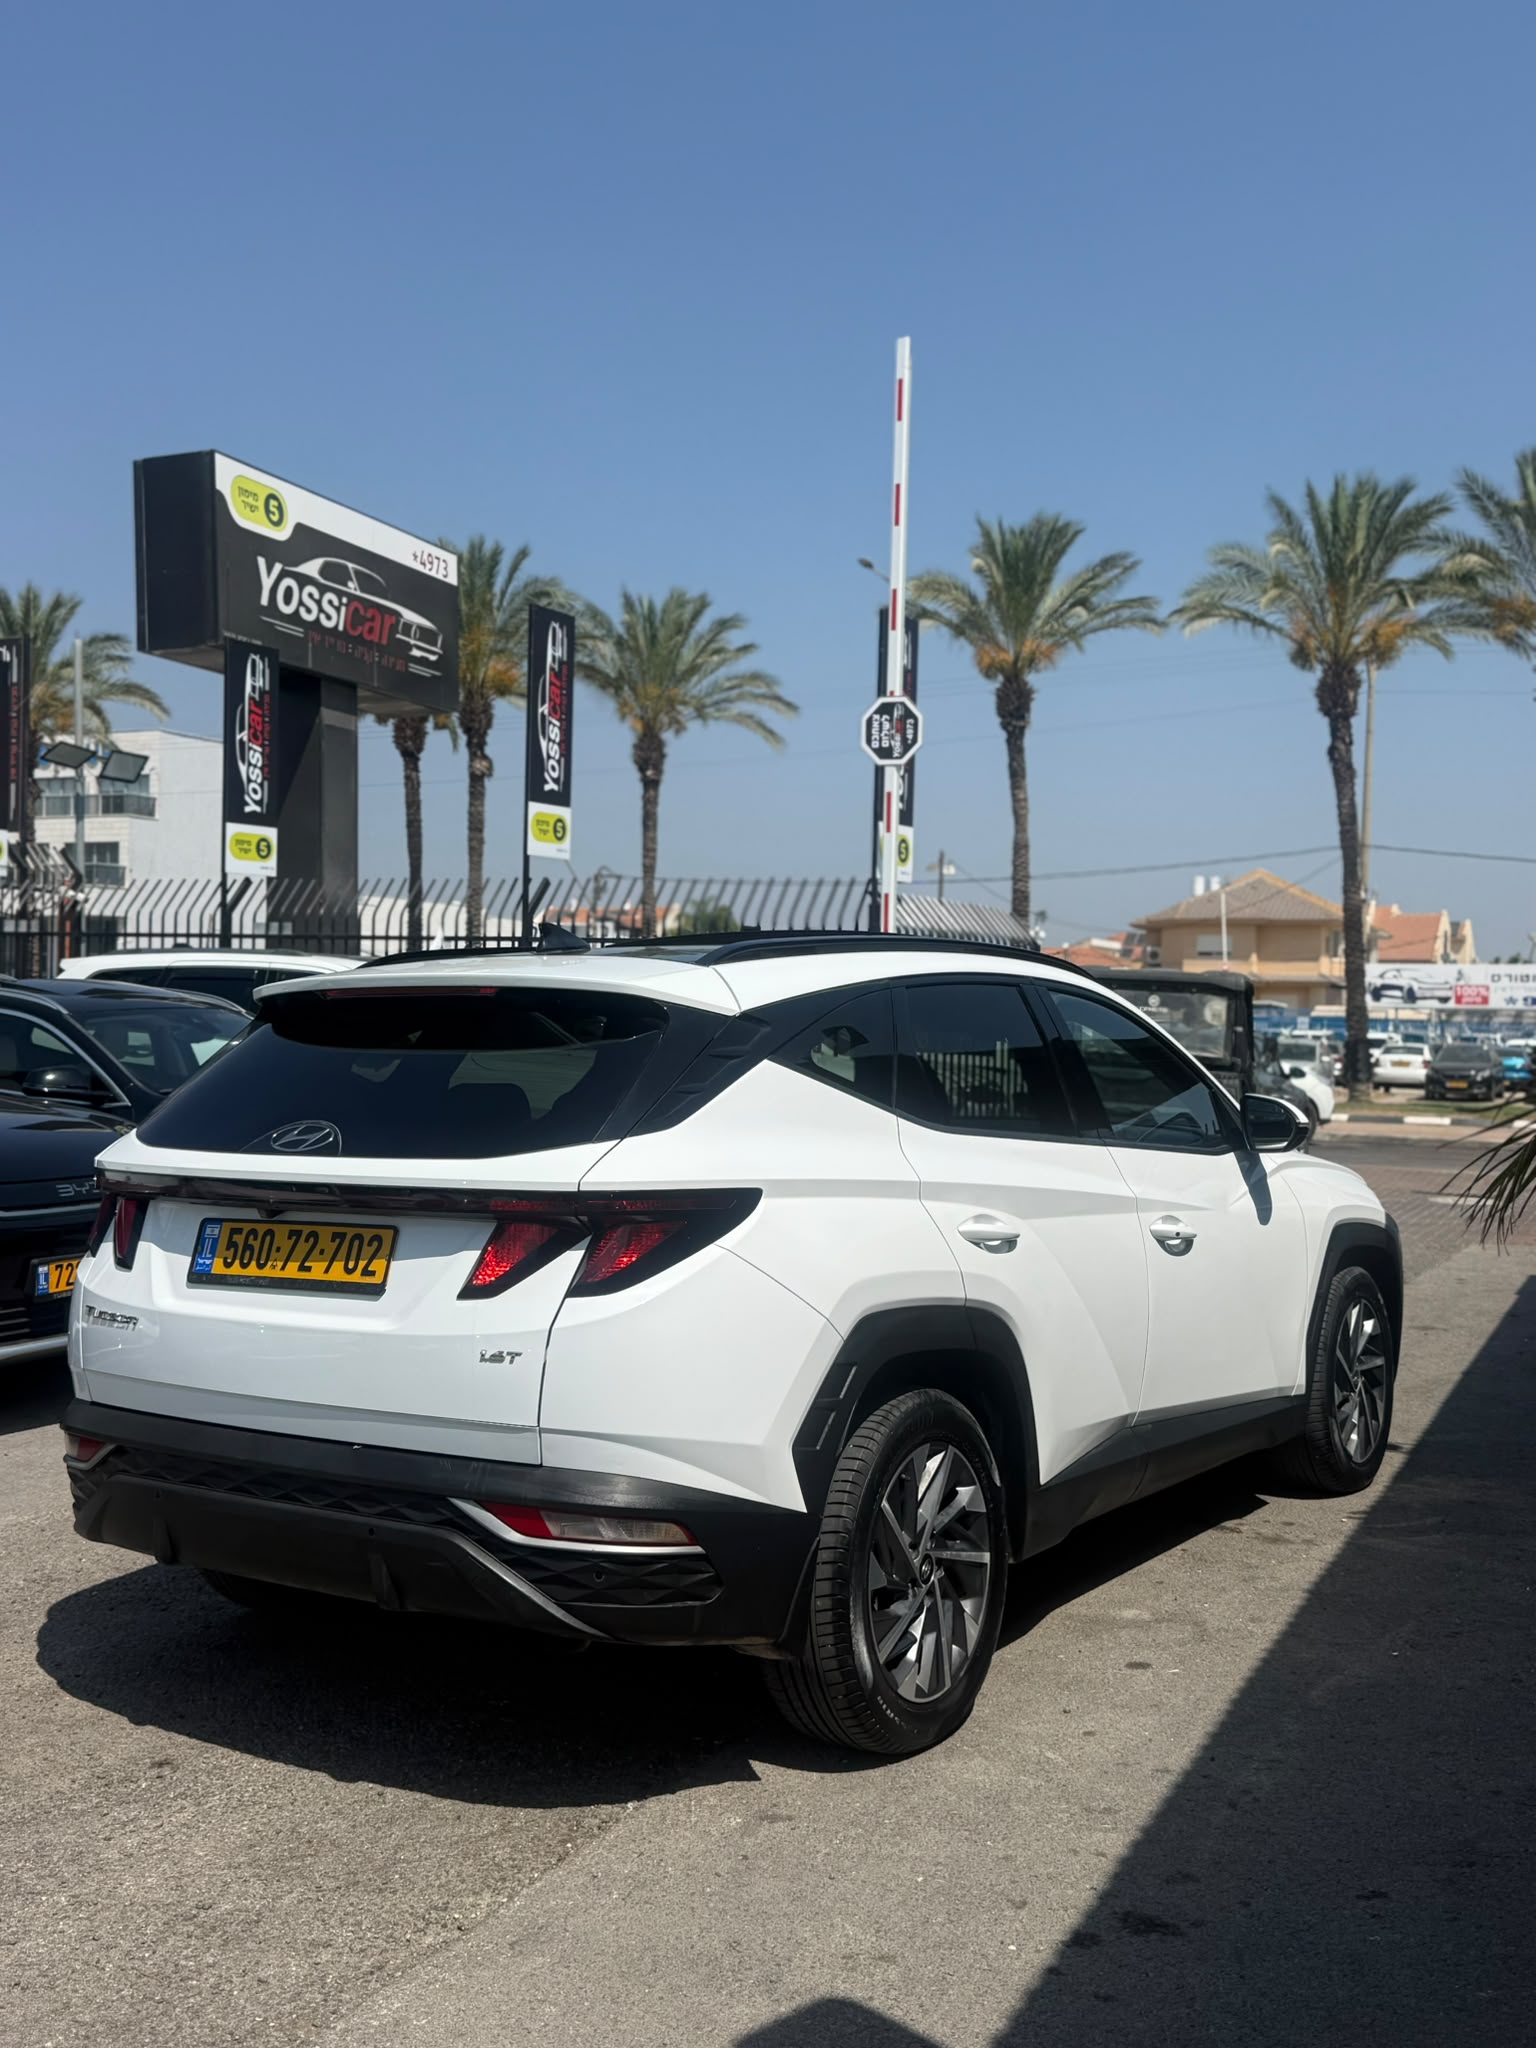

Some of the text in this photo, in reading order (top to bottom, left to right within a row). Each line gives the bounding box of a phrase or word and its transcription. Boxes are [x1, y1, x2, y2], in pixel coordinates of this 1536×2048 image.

[237, 485, 259, 502] מימון
[241, 499, 259, 513] ישיר
[268, 498, 280, 523] 5
[259, 841, 268, 857] 5
[202, 1238, 213, 1258] IL
[55, 1260, 80, 1289] 72
